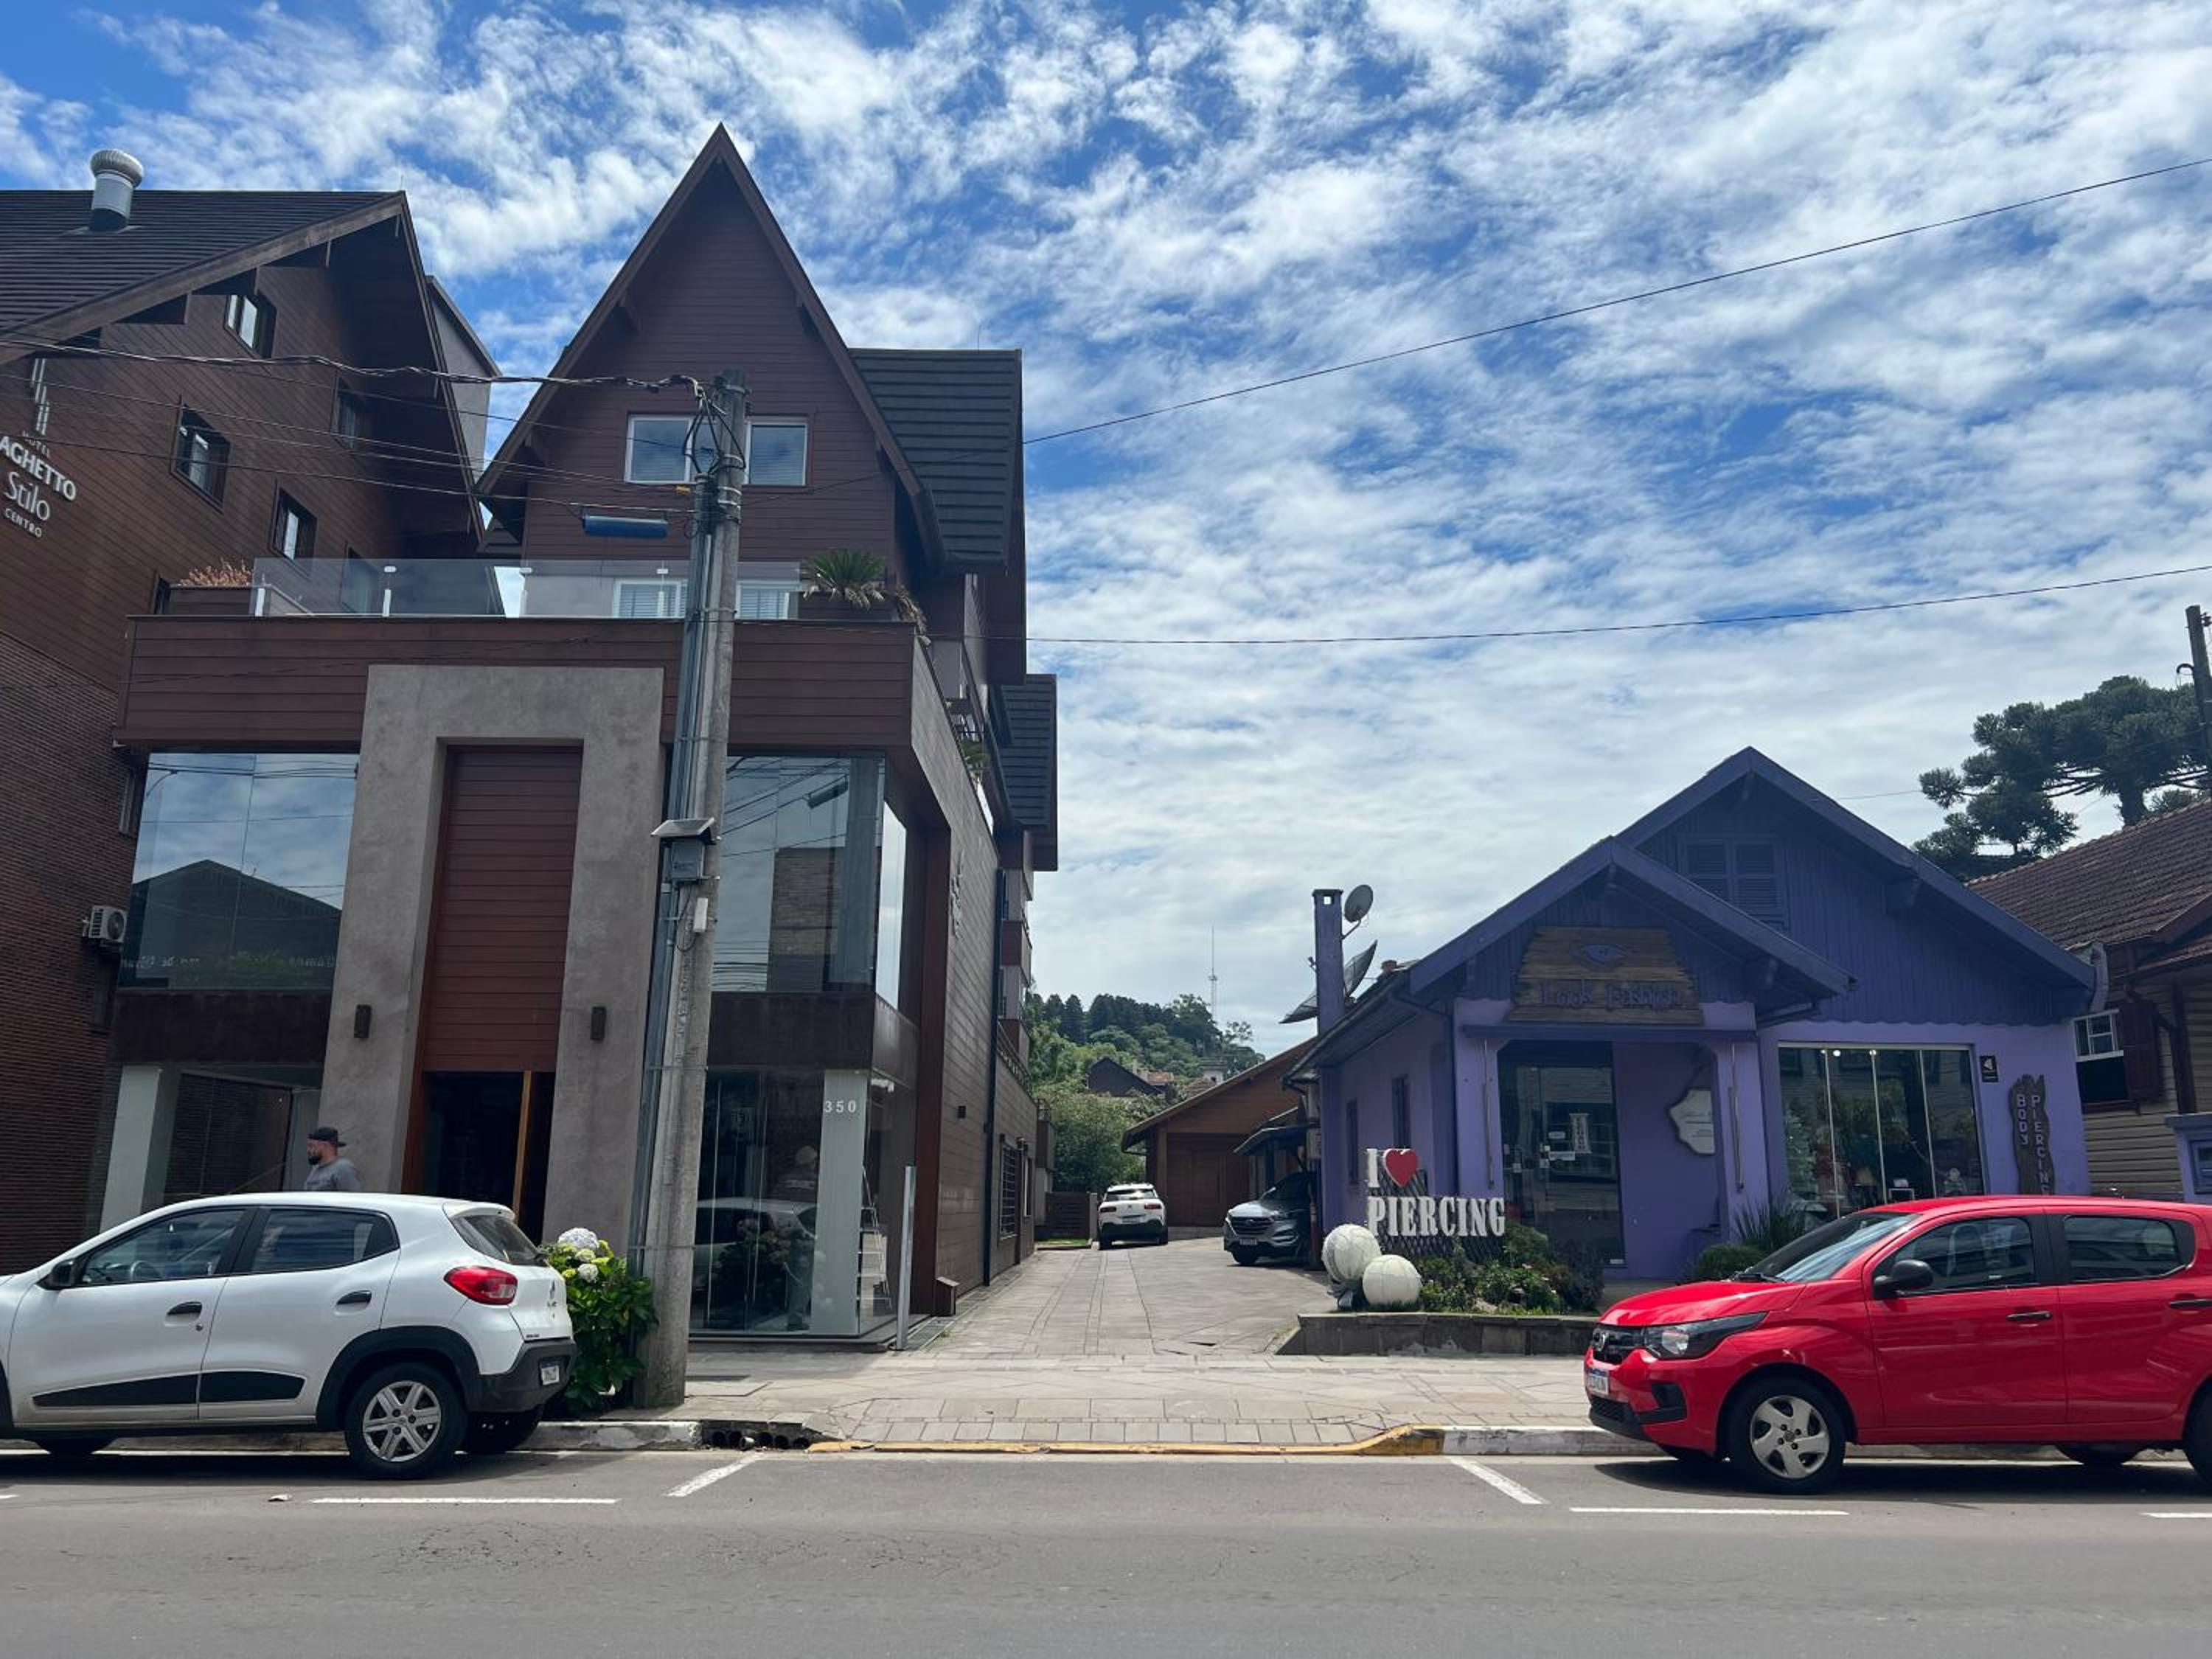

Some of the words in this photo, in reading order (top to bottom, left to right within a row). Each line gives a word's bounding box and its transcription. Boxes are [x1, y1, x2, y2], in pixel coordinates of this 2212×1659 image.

[4, 471, 50, 521] Stilo
[5, 508, 42, 538] CENTRO
[825, 1099, 857, 1113] 350
[2017, 1093, 2028, 1145] BODY
[2031, 1094, 2049, 1194] PIERCING
[1366, 1148, 1380, 1189] I
[1367, 1196, 1506, 1237] PIERCING
